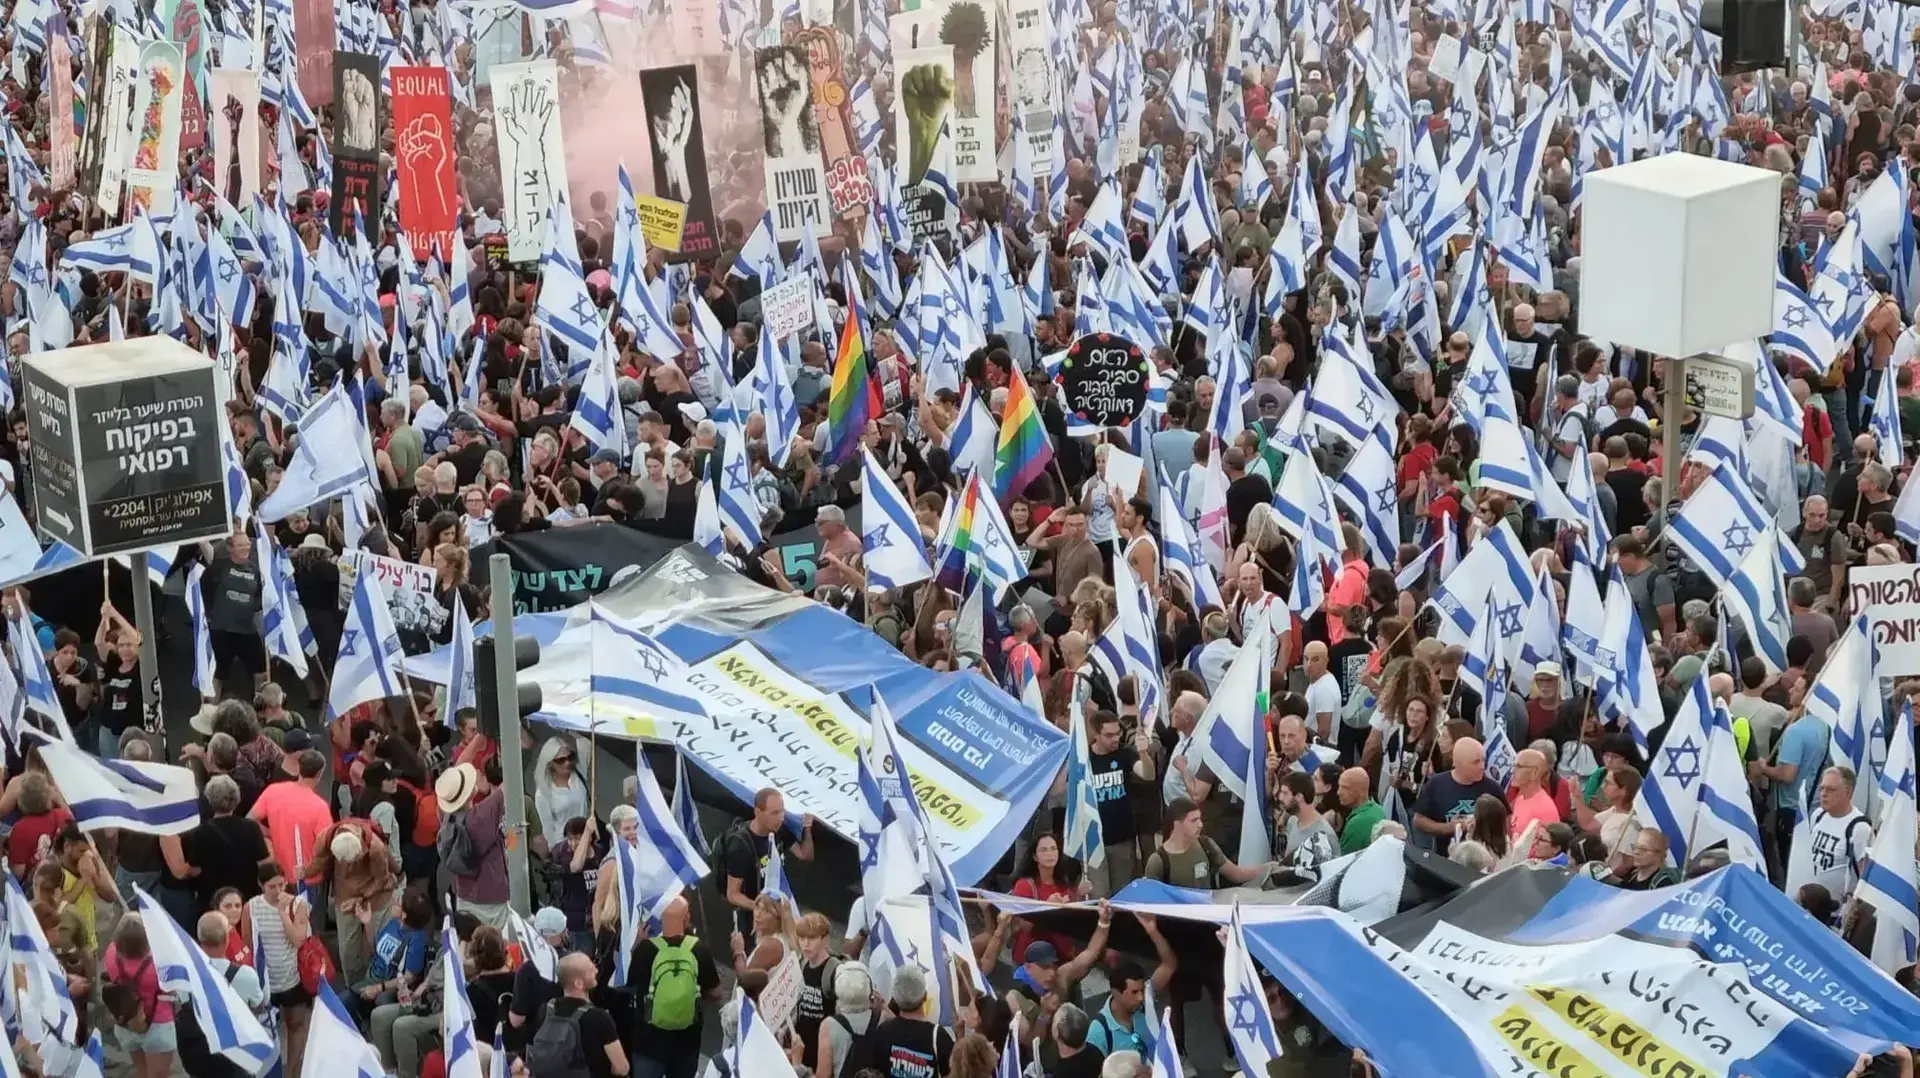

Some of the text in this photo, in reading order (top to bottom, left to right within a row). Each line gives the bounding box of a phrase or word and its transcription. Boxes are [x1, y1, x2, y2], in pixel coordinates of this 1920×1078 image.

[396, 76, 446, 96] EQUAL
[1084, 348, 1128, 367] האם
[1098, 369, 1140, 384] סביר
[92, 395, 204, 425] הסרת שיער בלייזר
[105, 416, 196, 452] בפיקוח
[119, 445, 190, 476] רפואי
[173, 506, 201, 519] רפואת
[551, 564, 603, 591] לצד
[720, 657, 766, 688] אלא
[927, 721, 994, 770] מנחם בגין
[1743, 926, 1784, 960] עורכי
[1820, 981, 1871, 1016] 2015
[1762, 973, 1826, 1014] הרצוג
[1628, 969, 1733, 1056] הפילגש
